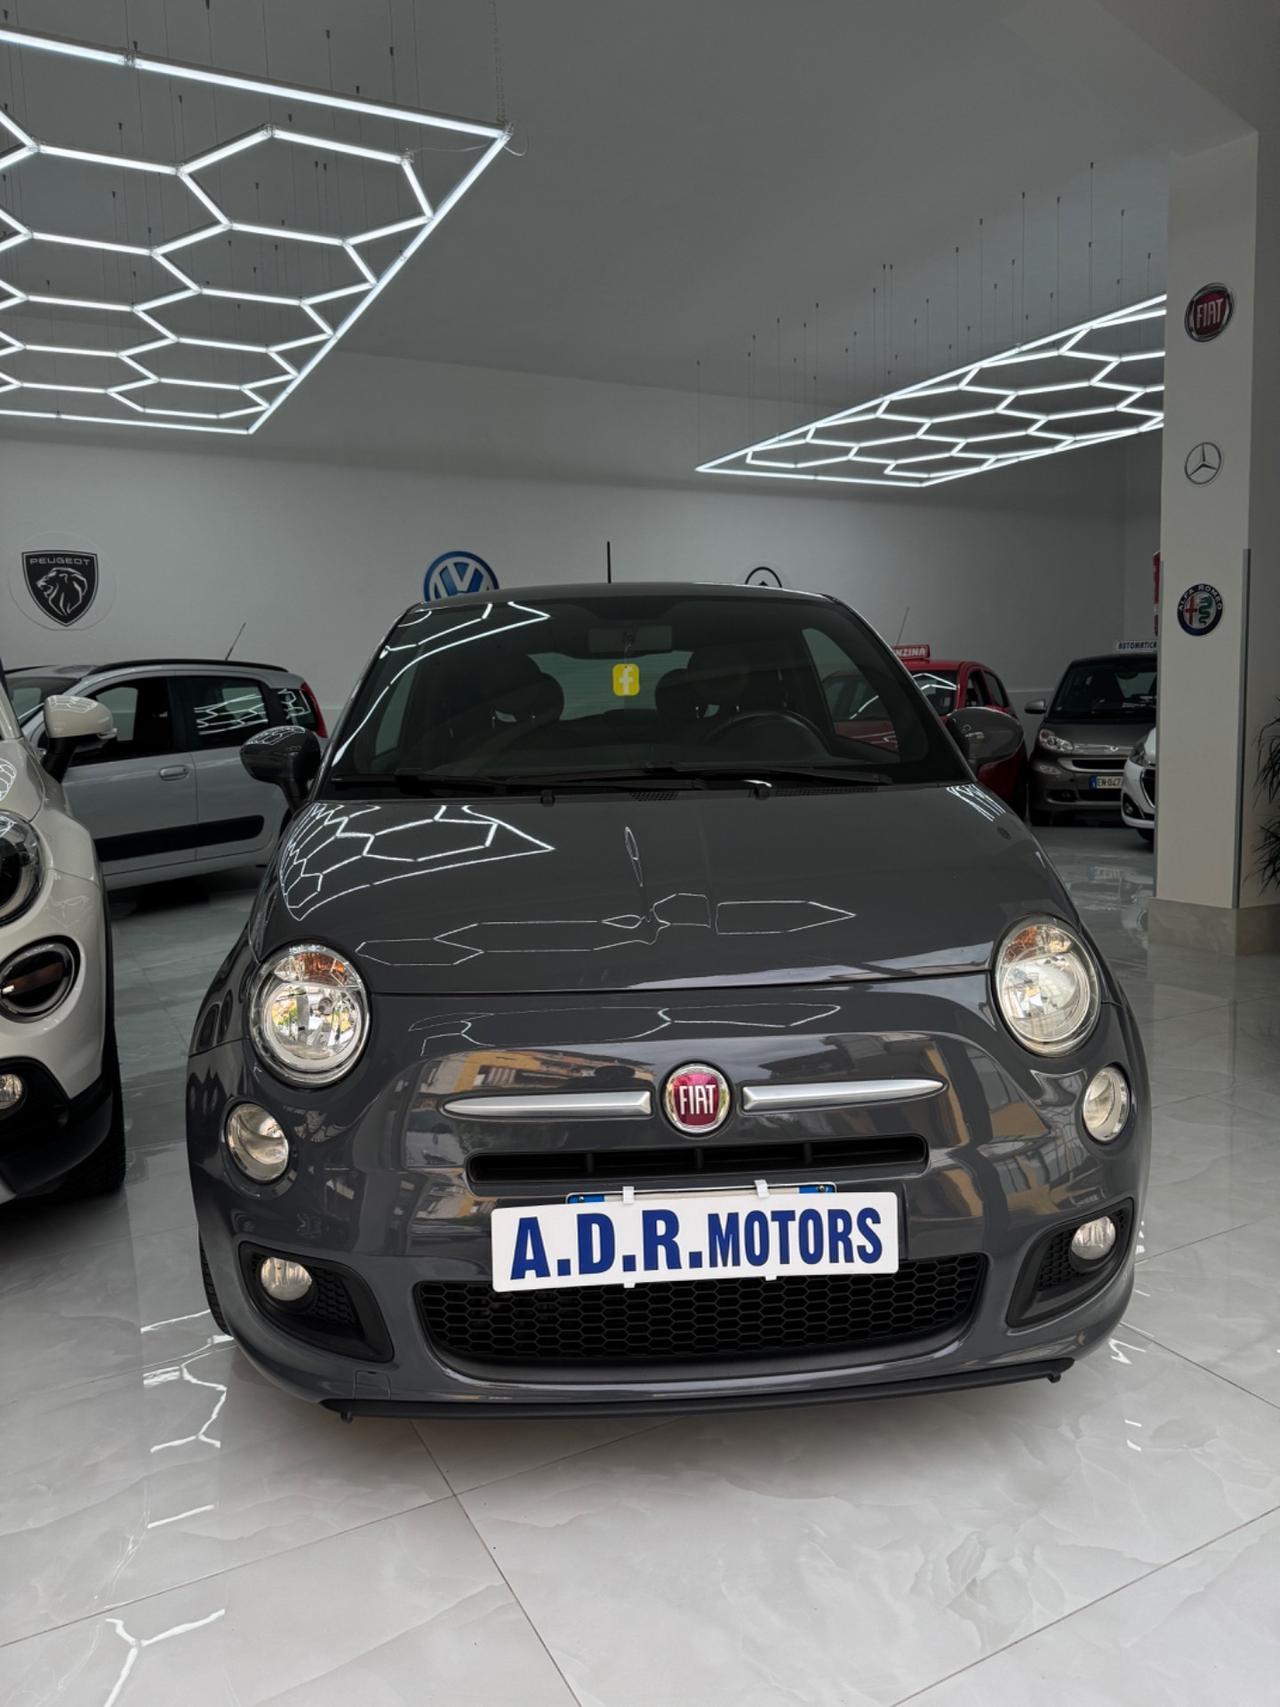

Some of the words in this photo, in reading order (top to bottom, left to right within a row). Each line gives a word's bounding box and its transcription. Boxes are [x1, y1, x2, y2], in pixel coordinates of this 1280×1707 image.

[1197, 298, 1224, 328] FIAT
[29, 557, 91, 566] PEUGEOT
[1178, 588, 1195, 610] ALFA
[1198, 584, 1222, 610] ROMEO
[893, 647, 926, 657] NZINA
[679, 1084, 716, 1115] FIAT
